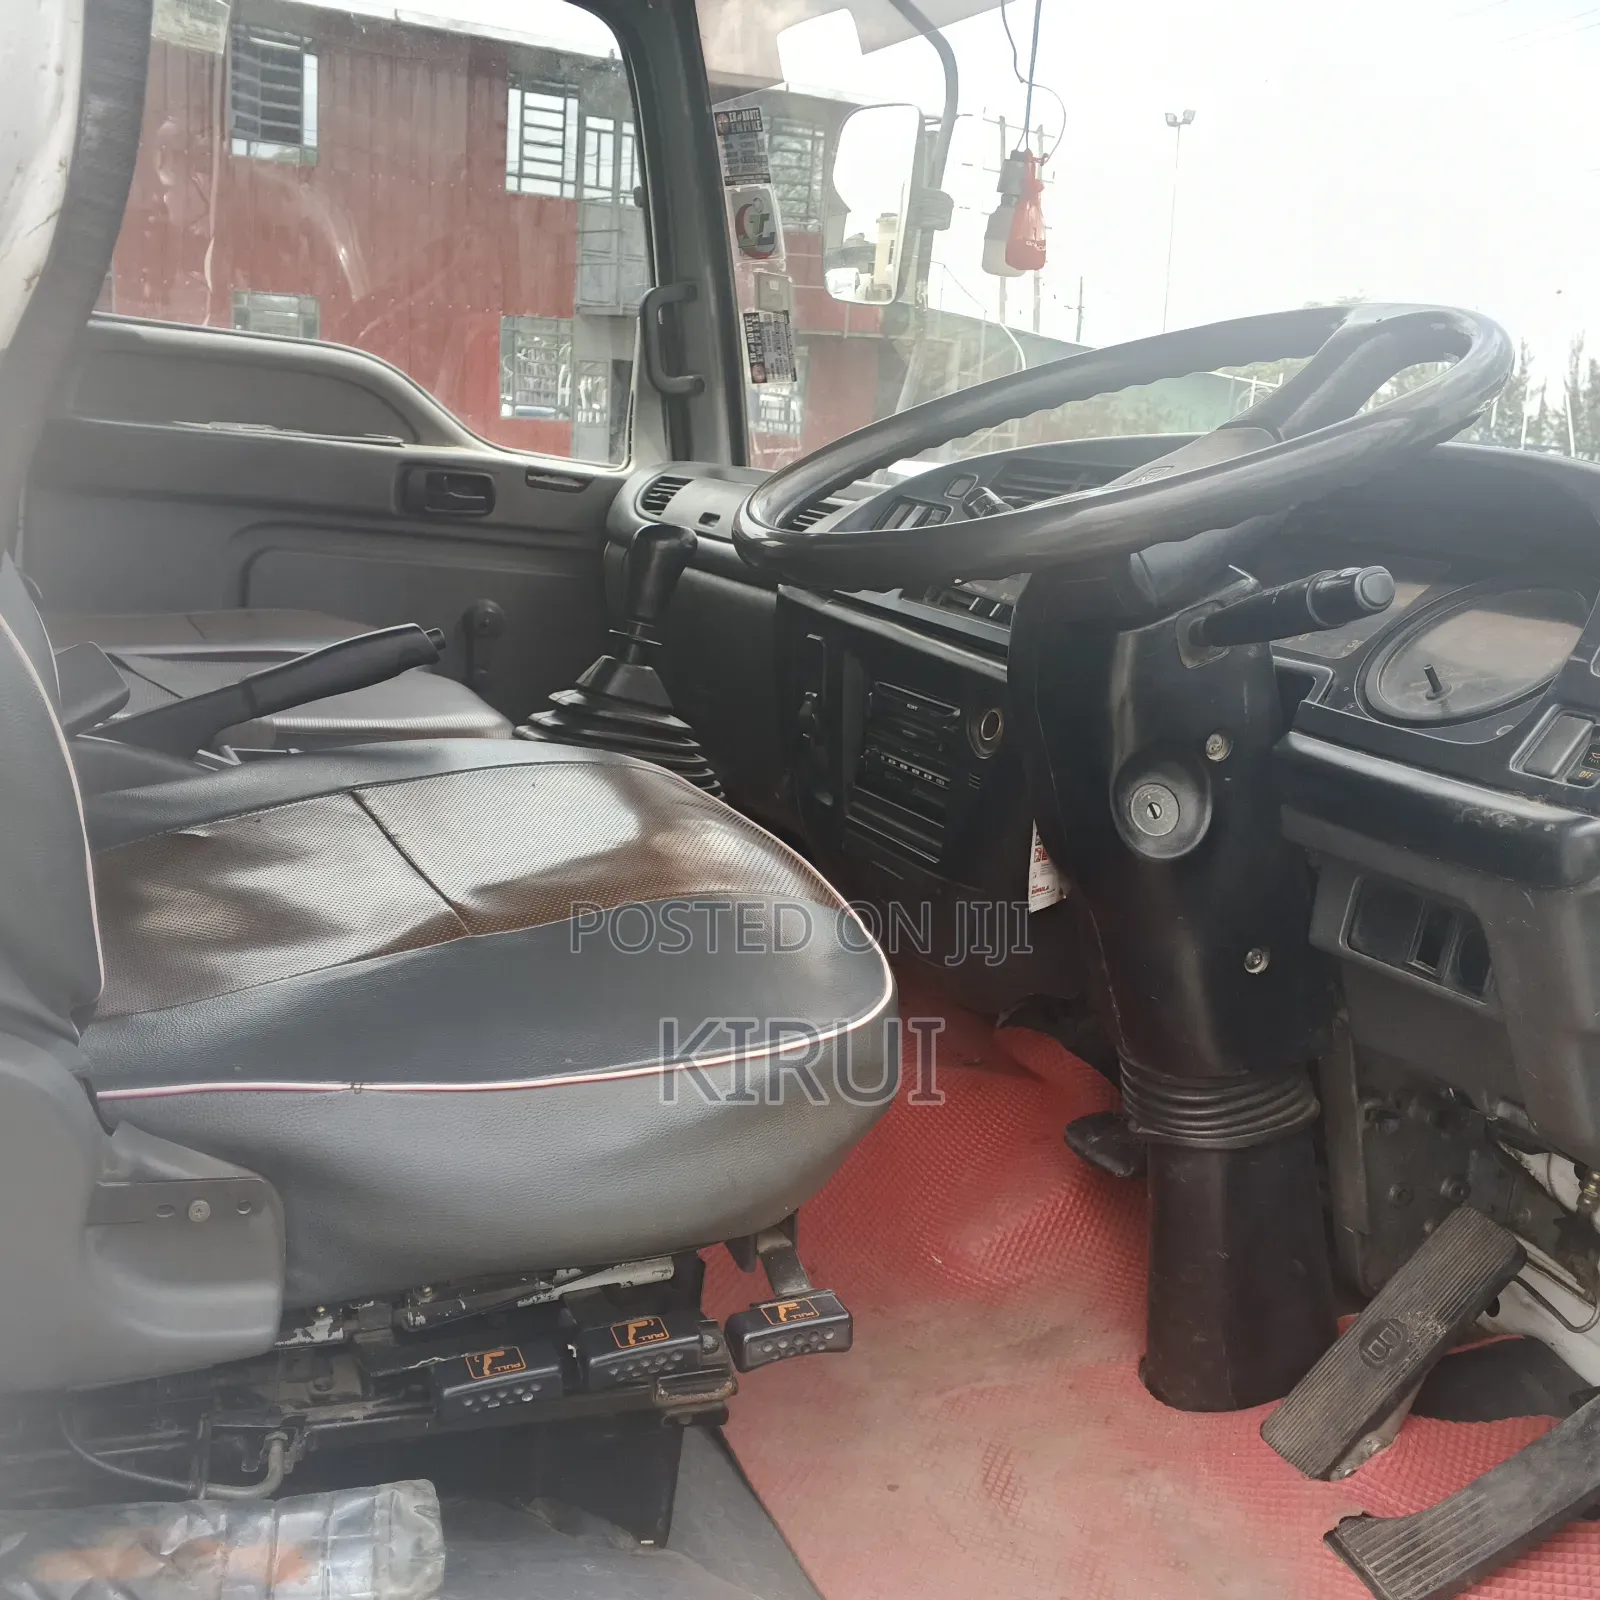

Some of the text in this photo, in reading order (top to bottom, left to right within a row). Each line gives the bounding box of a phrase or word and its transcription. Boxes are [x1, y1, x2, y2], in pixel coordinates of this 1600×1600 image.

[745, 315, 755, 344] ROUTE
[789, 1311, 815, 1319] PULL
[638, 1332, 665, 1341] PULL
[493, 1362, 521, 1371] PULL
